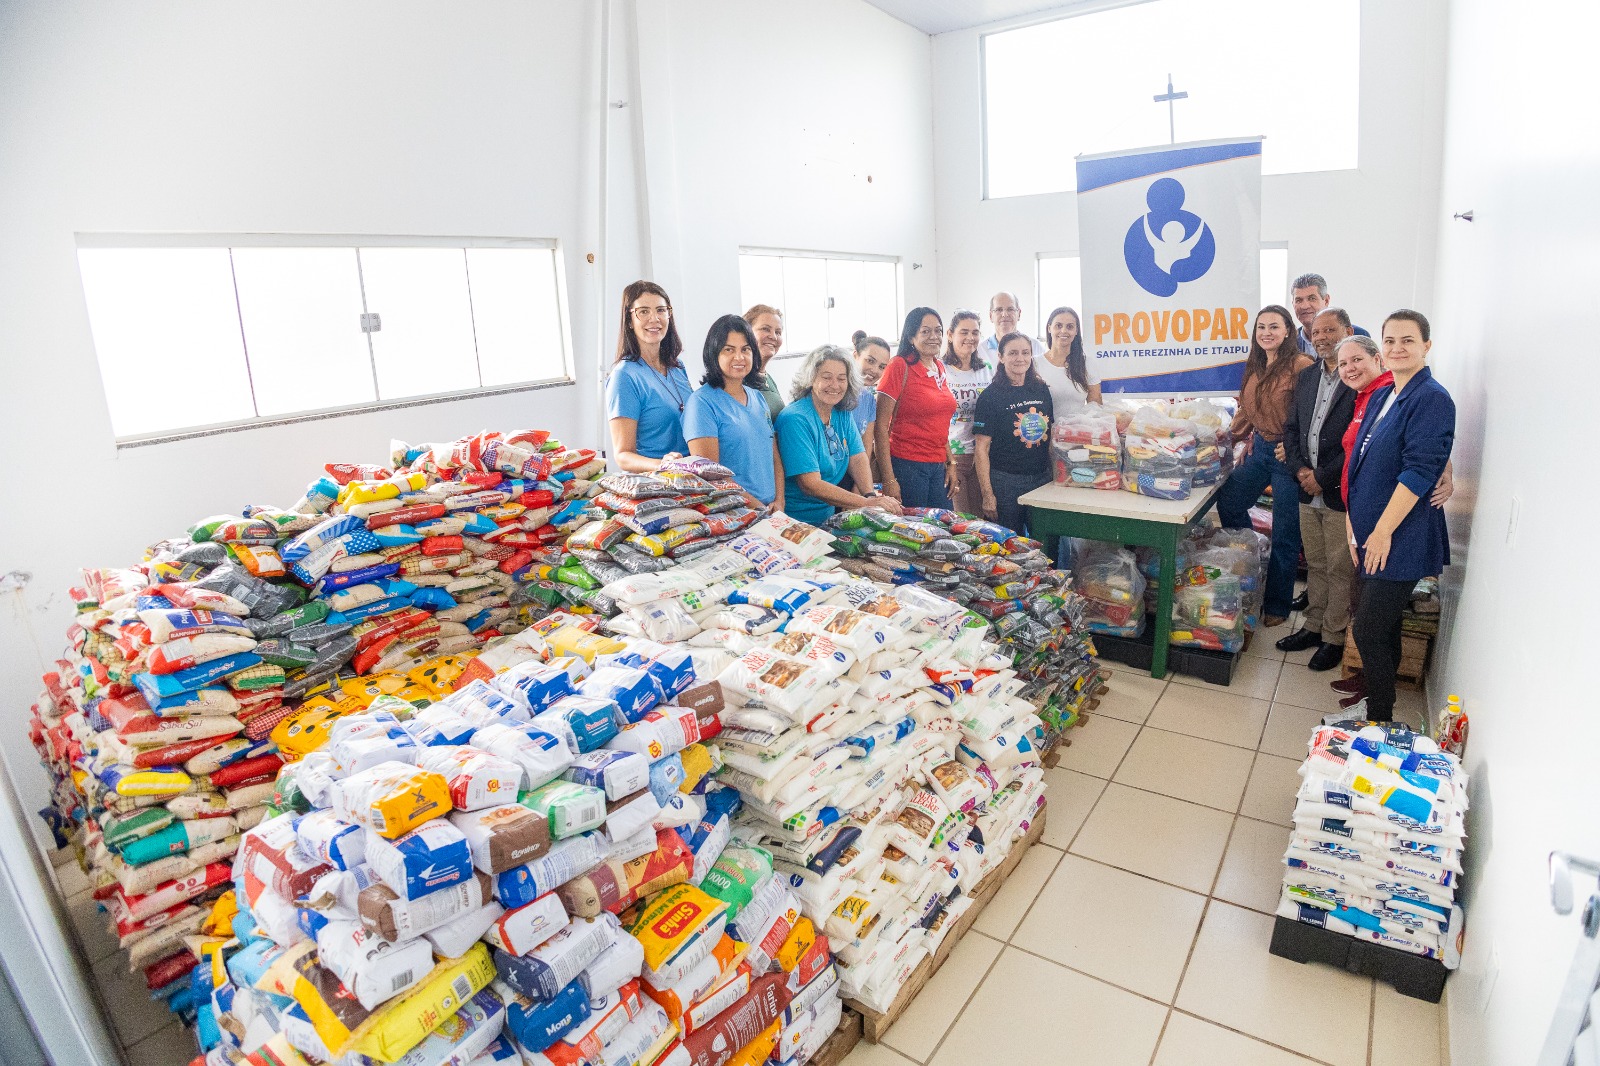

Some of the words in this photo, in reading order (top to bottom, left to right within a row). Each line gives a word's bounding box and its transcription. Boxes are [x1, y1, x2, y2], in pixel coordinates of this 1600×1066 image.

[1094, 307, 1249, 346] PROVOPAR
[1096, 349, 1129, 359] SANTA
[1133, 347, 1191, 357] TEREZINHA
[1194, 346, 1208, 355] DE
[1212, 345, 1249, 355] ITAIPU
[486, 778, 501, 793] Sol
[917, 791, 938, 803] ALTO
[707, 872, 731, 889] 0000
[660, 904, 694, 936] Sinhá
[766, 982, 779, 1018] Farina
[545, 1013, 573, 1036] Mona
